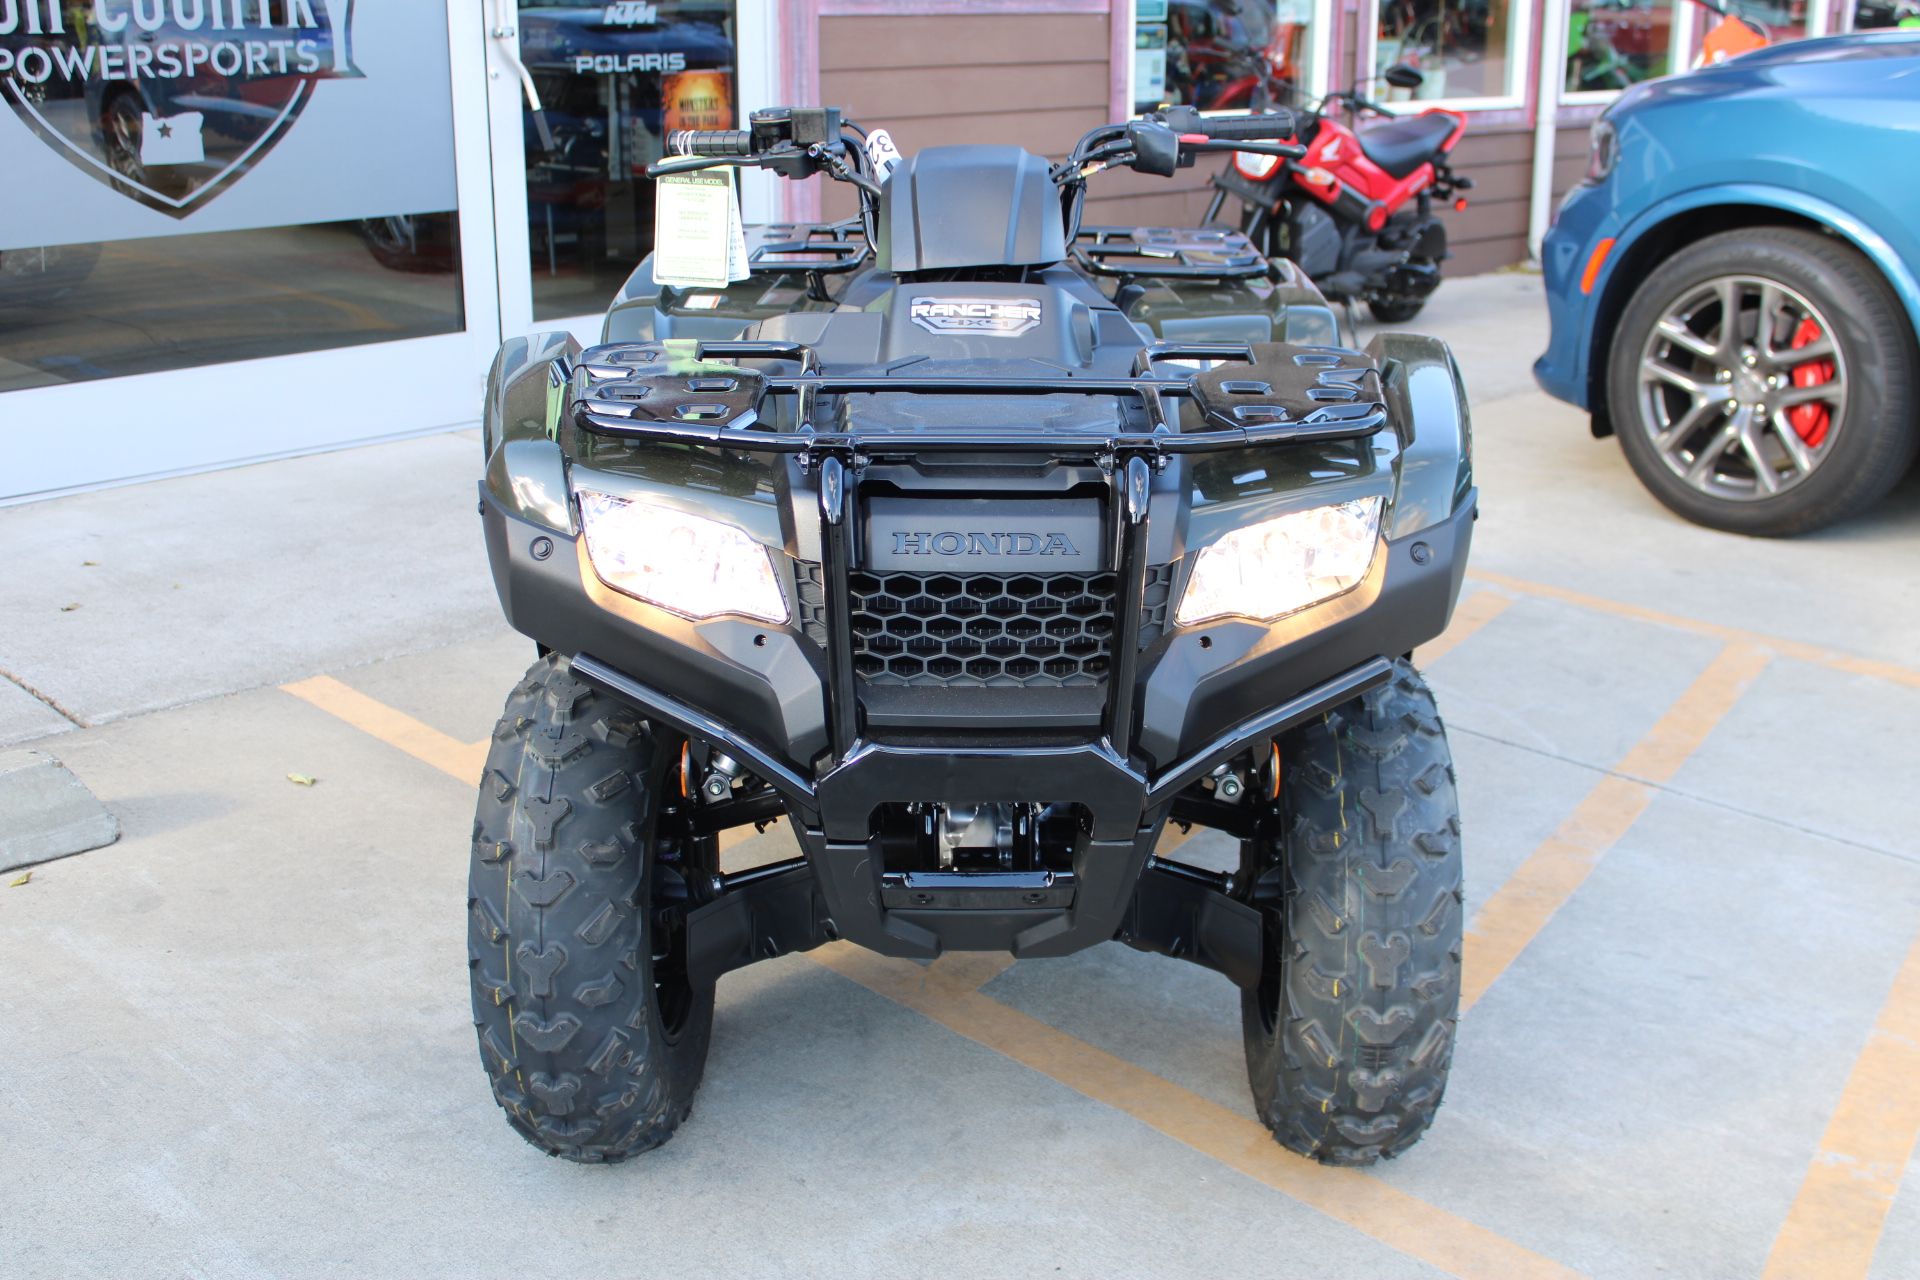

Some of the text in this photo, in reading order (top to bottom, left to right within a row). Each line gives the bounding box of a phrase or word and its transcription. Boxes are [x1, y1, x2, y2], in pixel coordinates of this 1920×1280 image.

[603, 1, 657, 26] KTM
[575, 53, 686, 74] POLARIS
[665, 176, 691, 184] GENERAL
[911, 304, 1041, 320] RANCHER
[891, 531, 1081, 556] HONDA
